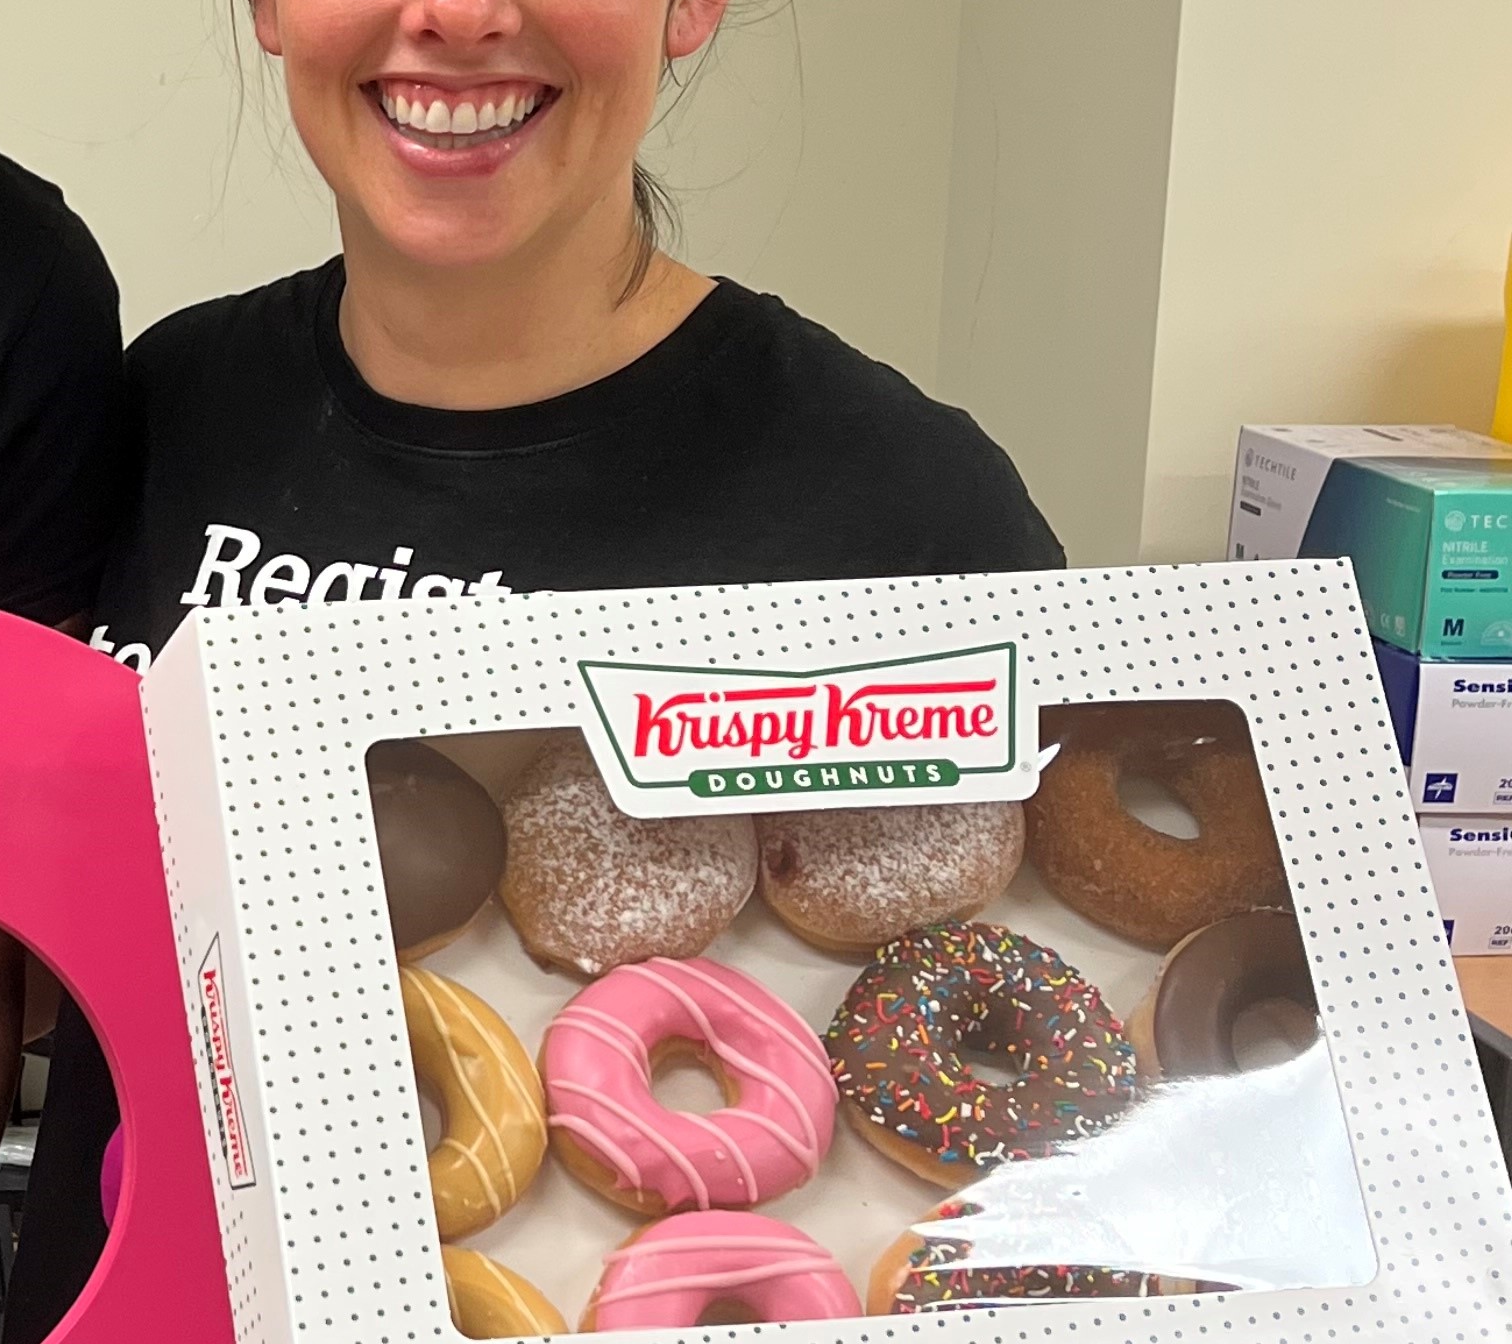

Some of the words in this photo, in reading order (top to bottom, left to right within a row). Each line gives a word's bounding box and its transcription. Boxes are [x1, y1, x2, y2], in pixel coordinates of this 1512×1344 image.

[1255, 455, 1297, 481] TECHTILE
[1470, 514, 1508, 529] TEC
[1442, 541, 1488, 553] NITRILE
[1442, 555, 1509, 565] Examination
[1442, 618, 1465, 637] M
[633, 684, 818, 759] Krispy
[825, 678, 999, 747] Kreme
[707, 764, 943, 793] DOUGHNUTS
[1450, 827, 1512, 842] Sensi
[203, 969, 233, 1072] Krispy
[219, 1075, 249, 1177] Kreme
